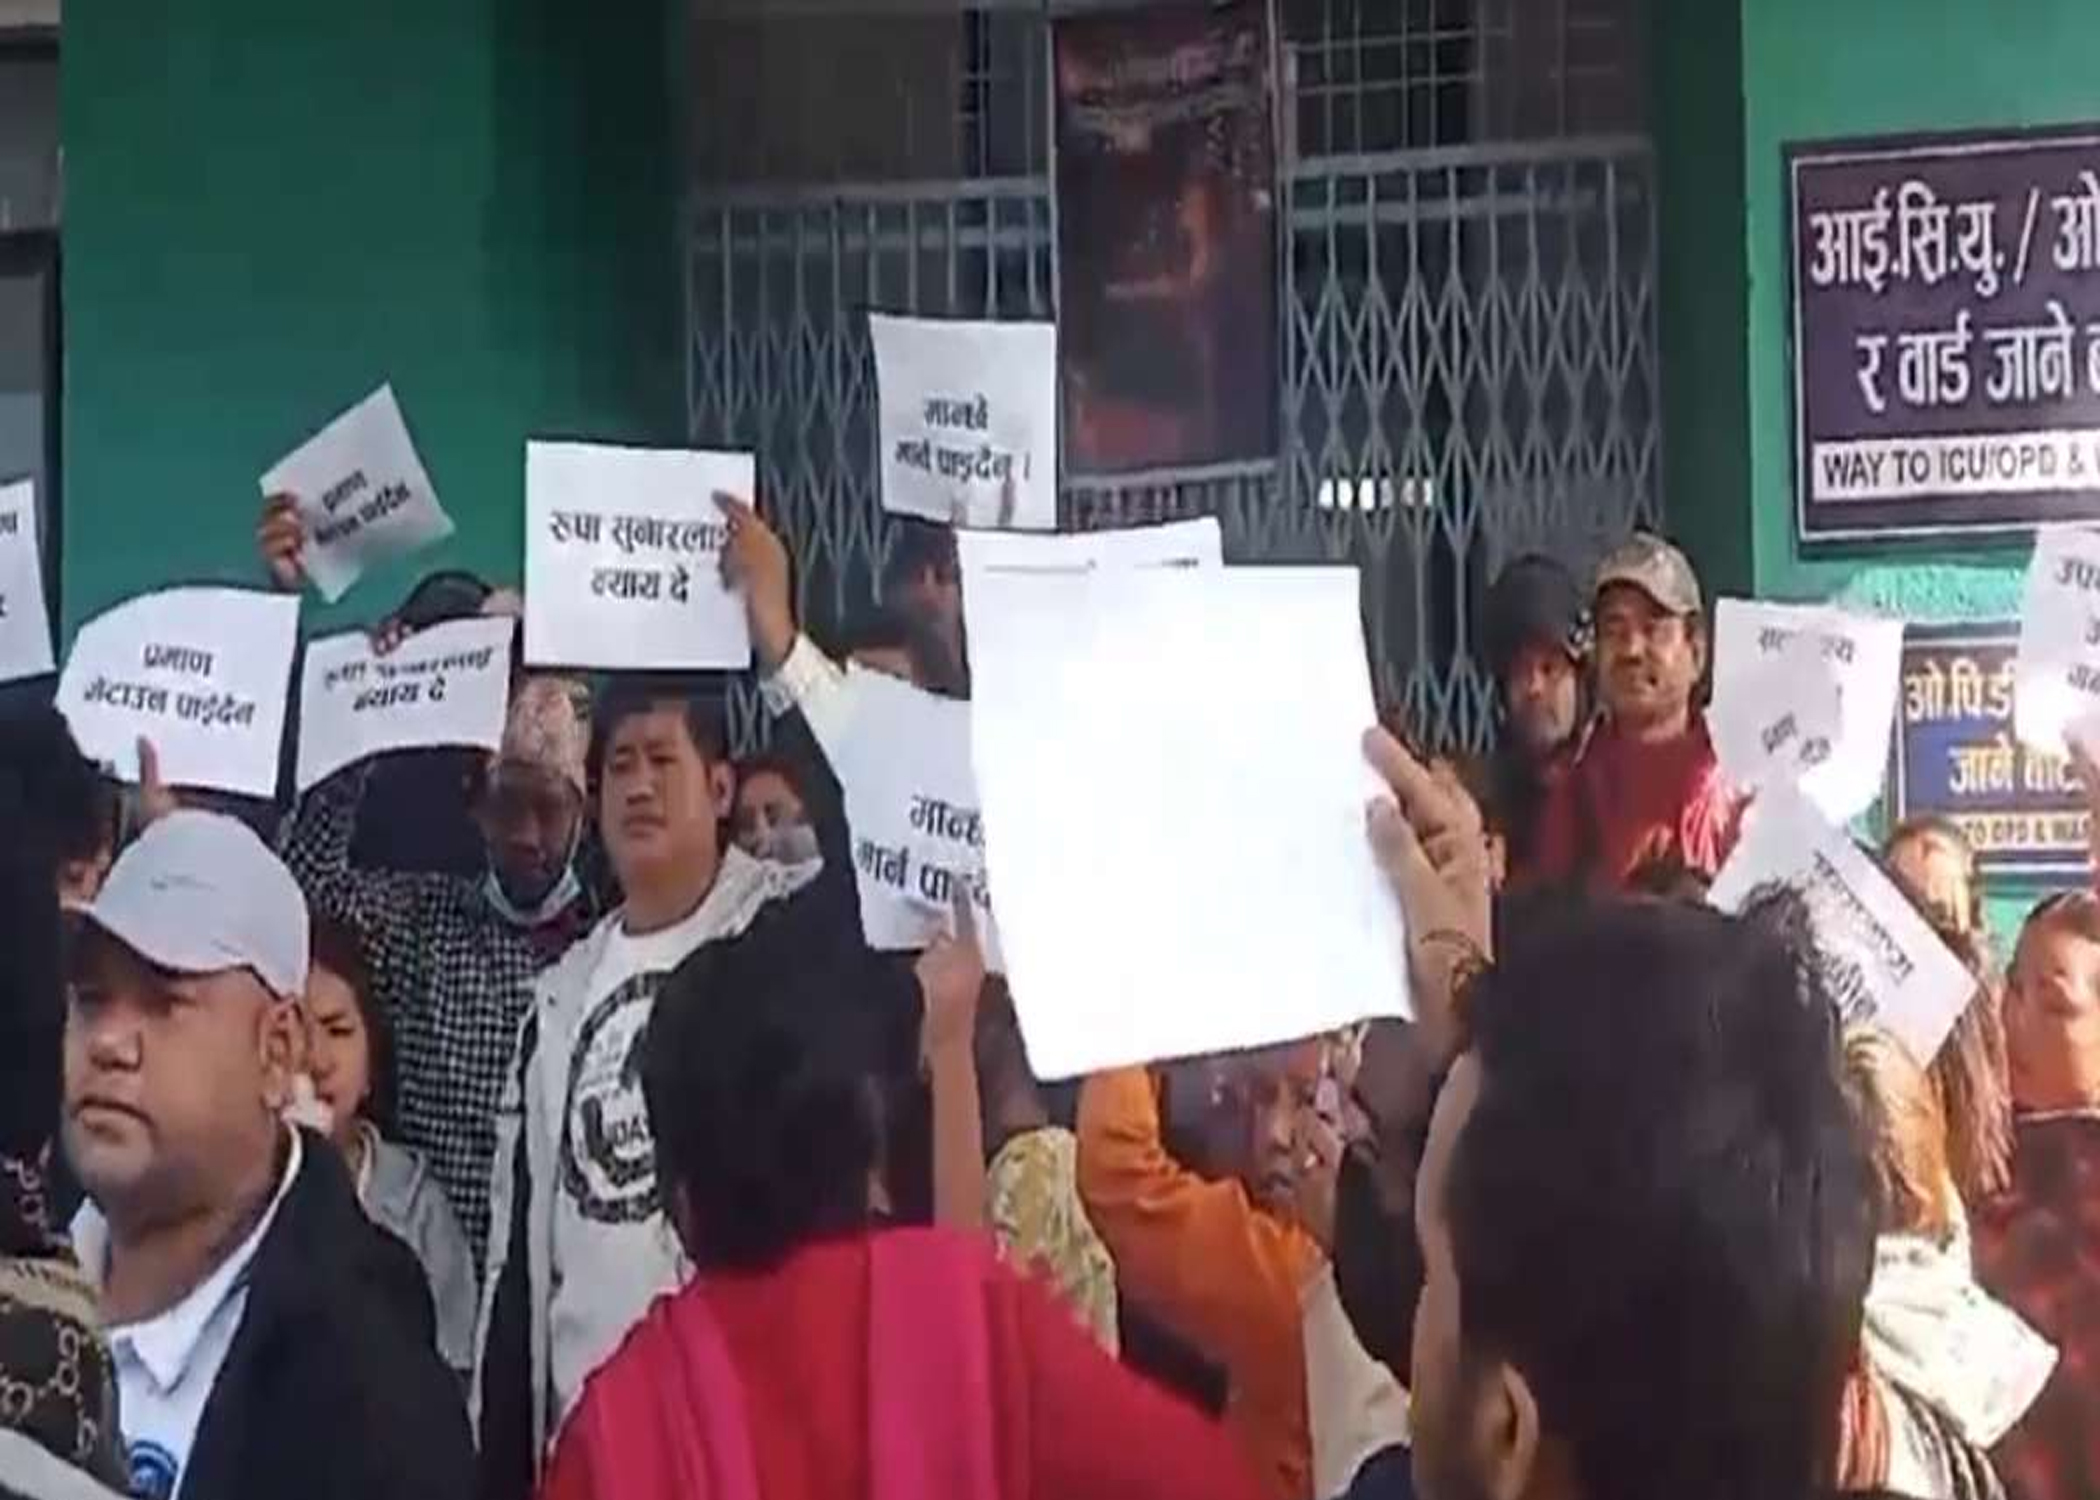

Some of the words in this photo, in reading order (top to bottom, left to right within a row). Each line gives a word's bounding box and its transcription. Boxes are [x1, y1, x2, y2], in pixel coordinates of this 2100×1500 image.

[1809, 181, 2005, 298] आई.सि.यु.
[1856, 335, 1889, 412] र
[1898, 308, 1973, 405] वार्ड
[1983, 300, 2076, 401] जाने
[1822, 453, 1885, 488] WAY
[1889, 449, 1931, 484] TO
[1938, 442, 2059, 482] ICU/OPD
[2067, 441, 2085, 478] &
[549, 510, 602, 543] रुपा
[590, 566, 662, 600] न्याय
[668, 563, 690, 604] दे
[143, 643, 214, 678] प्रमाण
